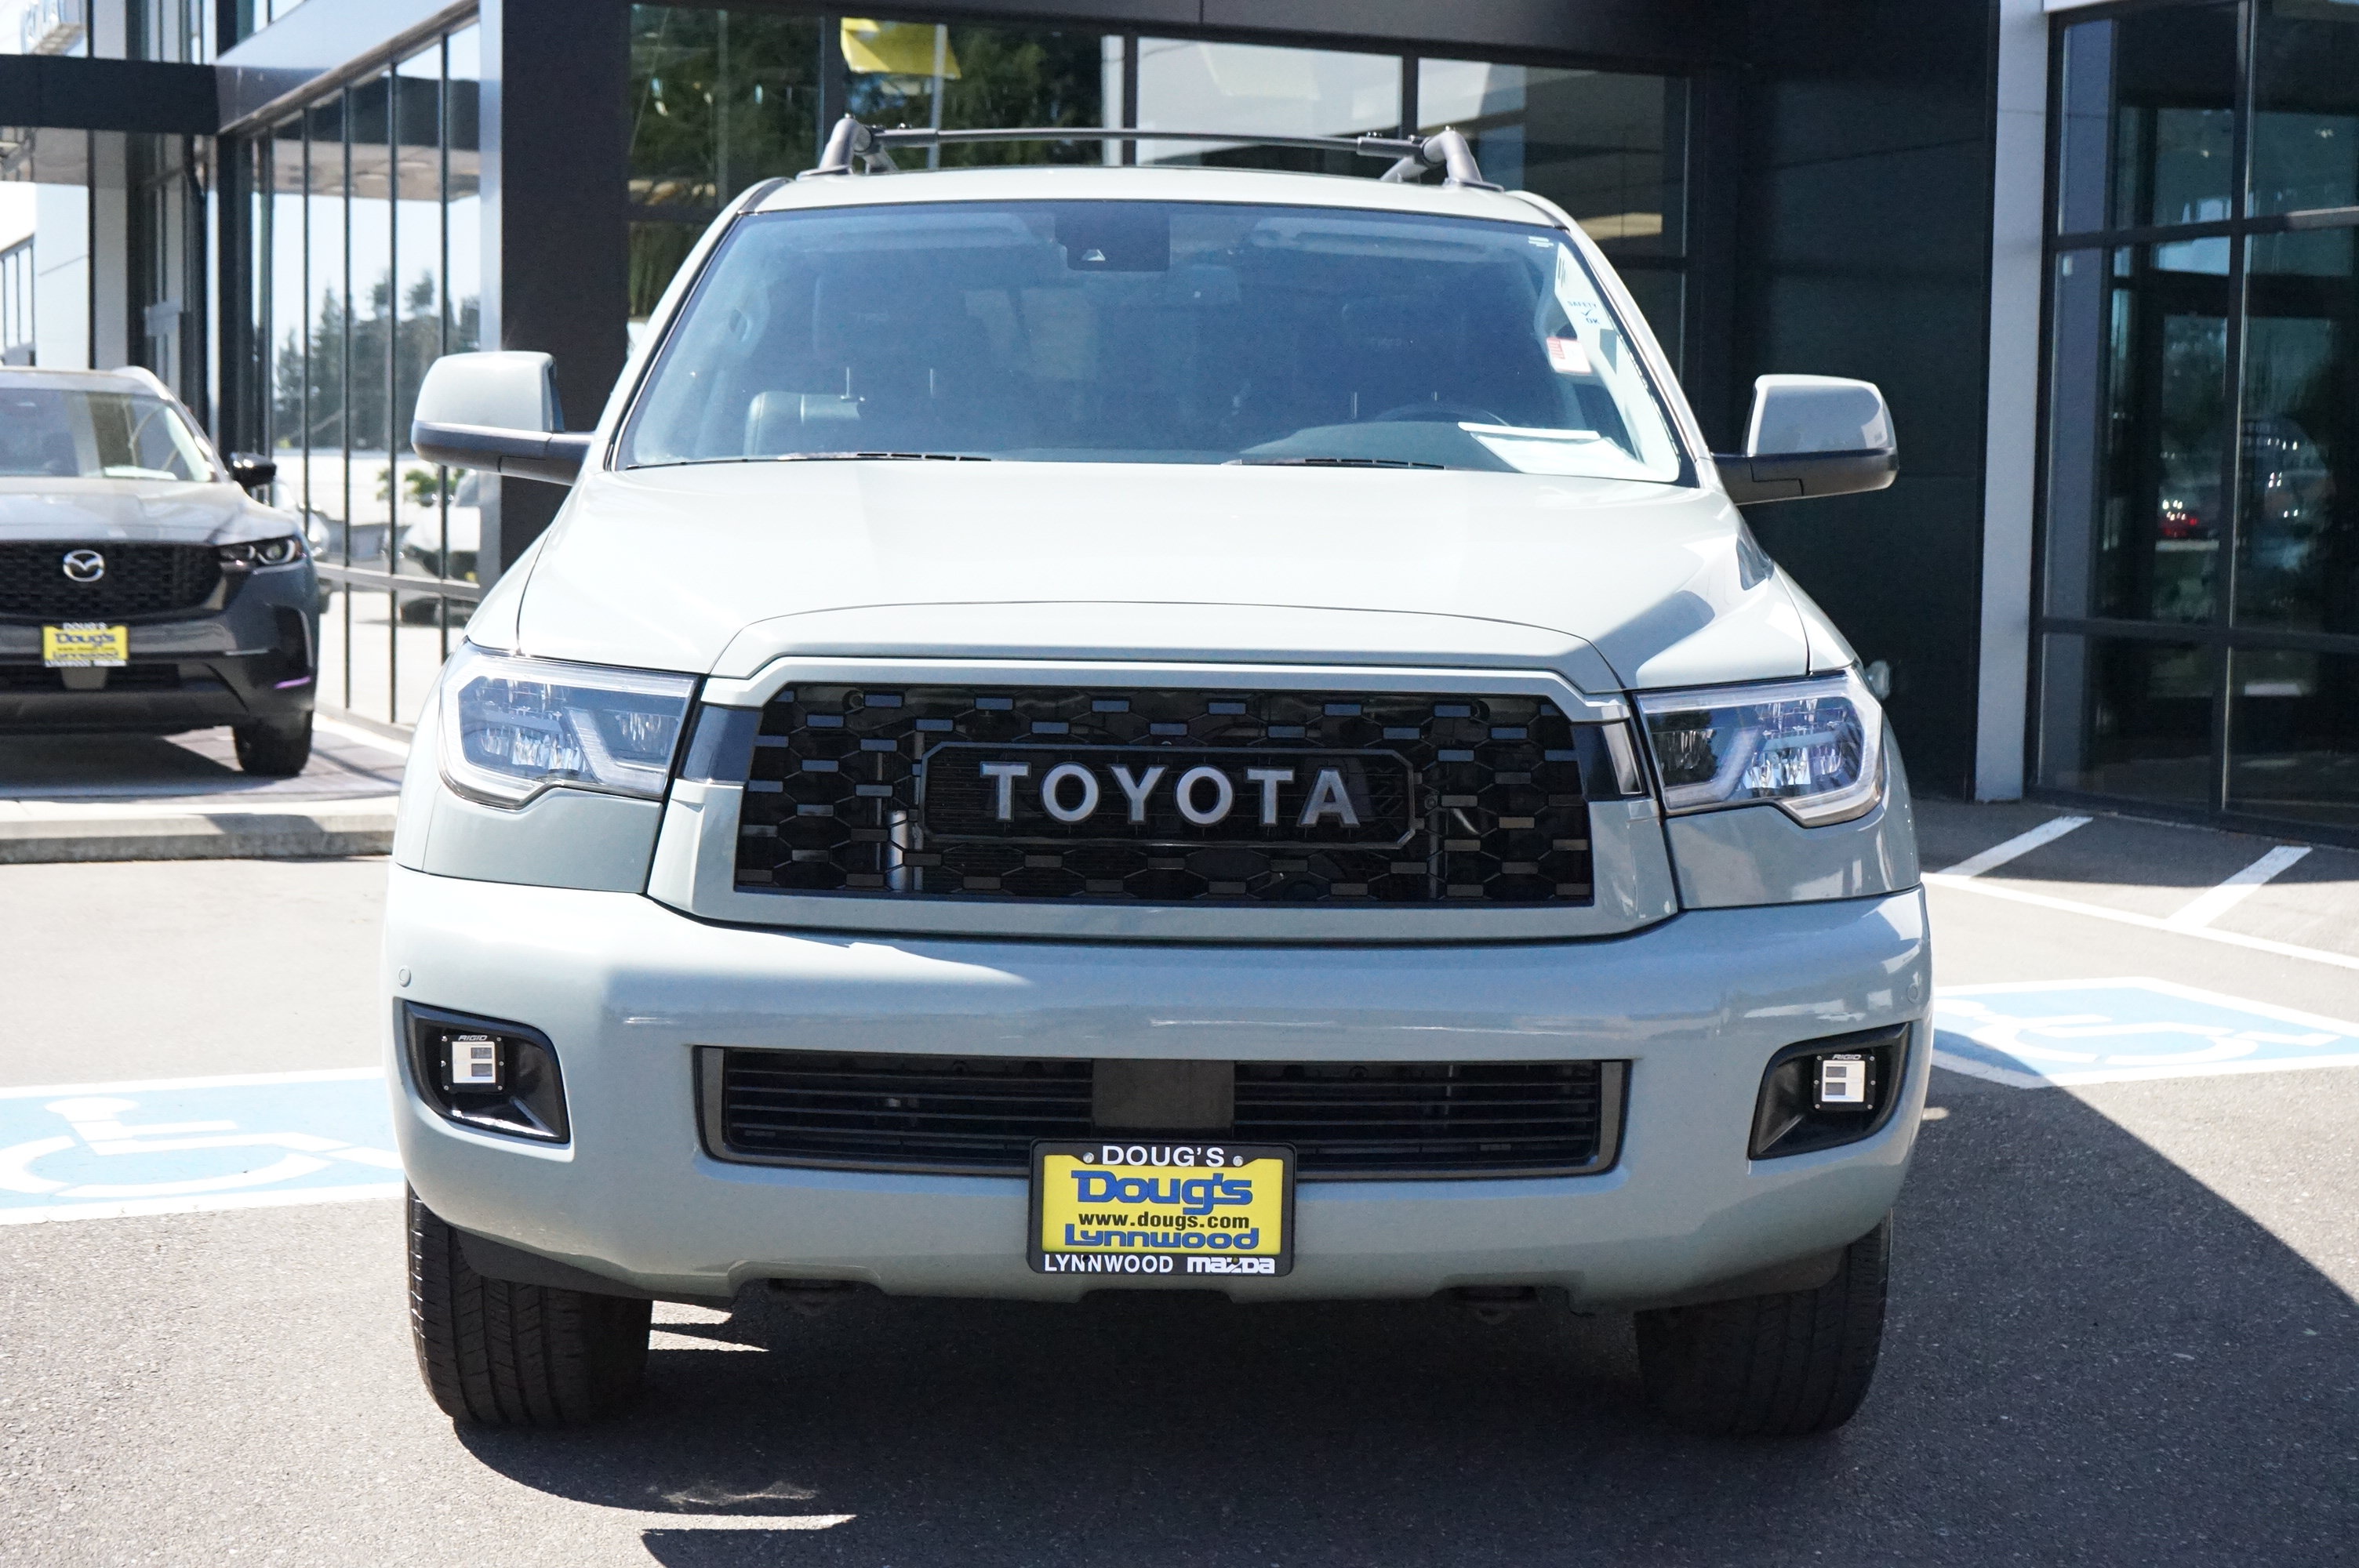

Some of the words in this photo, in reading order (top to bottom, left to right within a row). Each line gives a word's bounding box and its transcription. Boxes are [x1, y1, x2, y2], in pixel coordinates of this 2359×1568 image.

[980, 761, 1361, 827] TOYOTA
[1102, 1145, 1225, 1167] DOUG'S
[1071, 1171, 1253, 1215] Doug's
[1078, 1211, 1249, 1231] www.dougs.com
[1065, 1224, 1259, 1250] Lynnwood
[1045, 1254, 1173, 1272] LYNNWOOD
